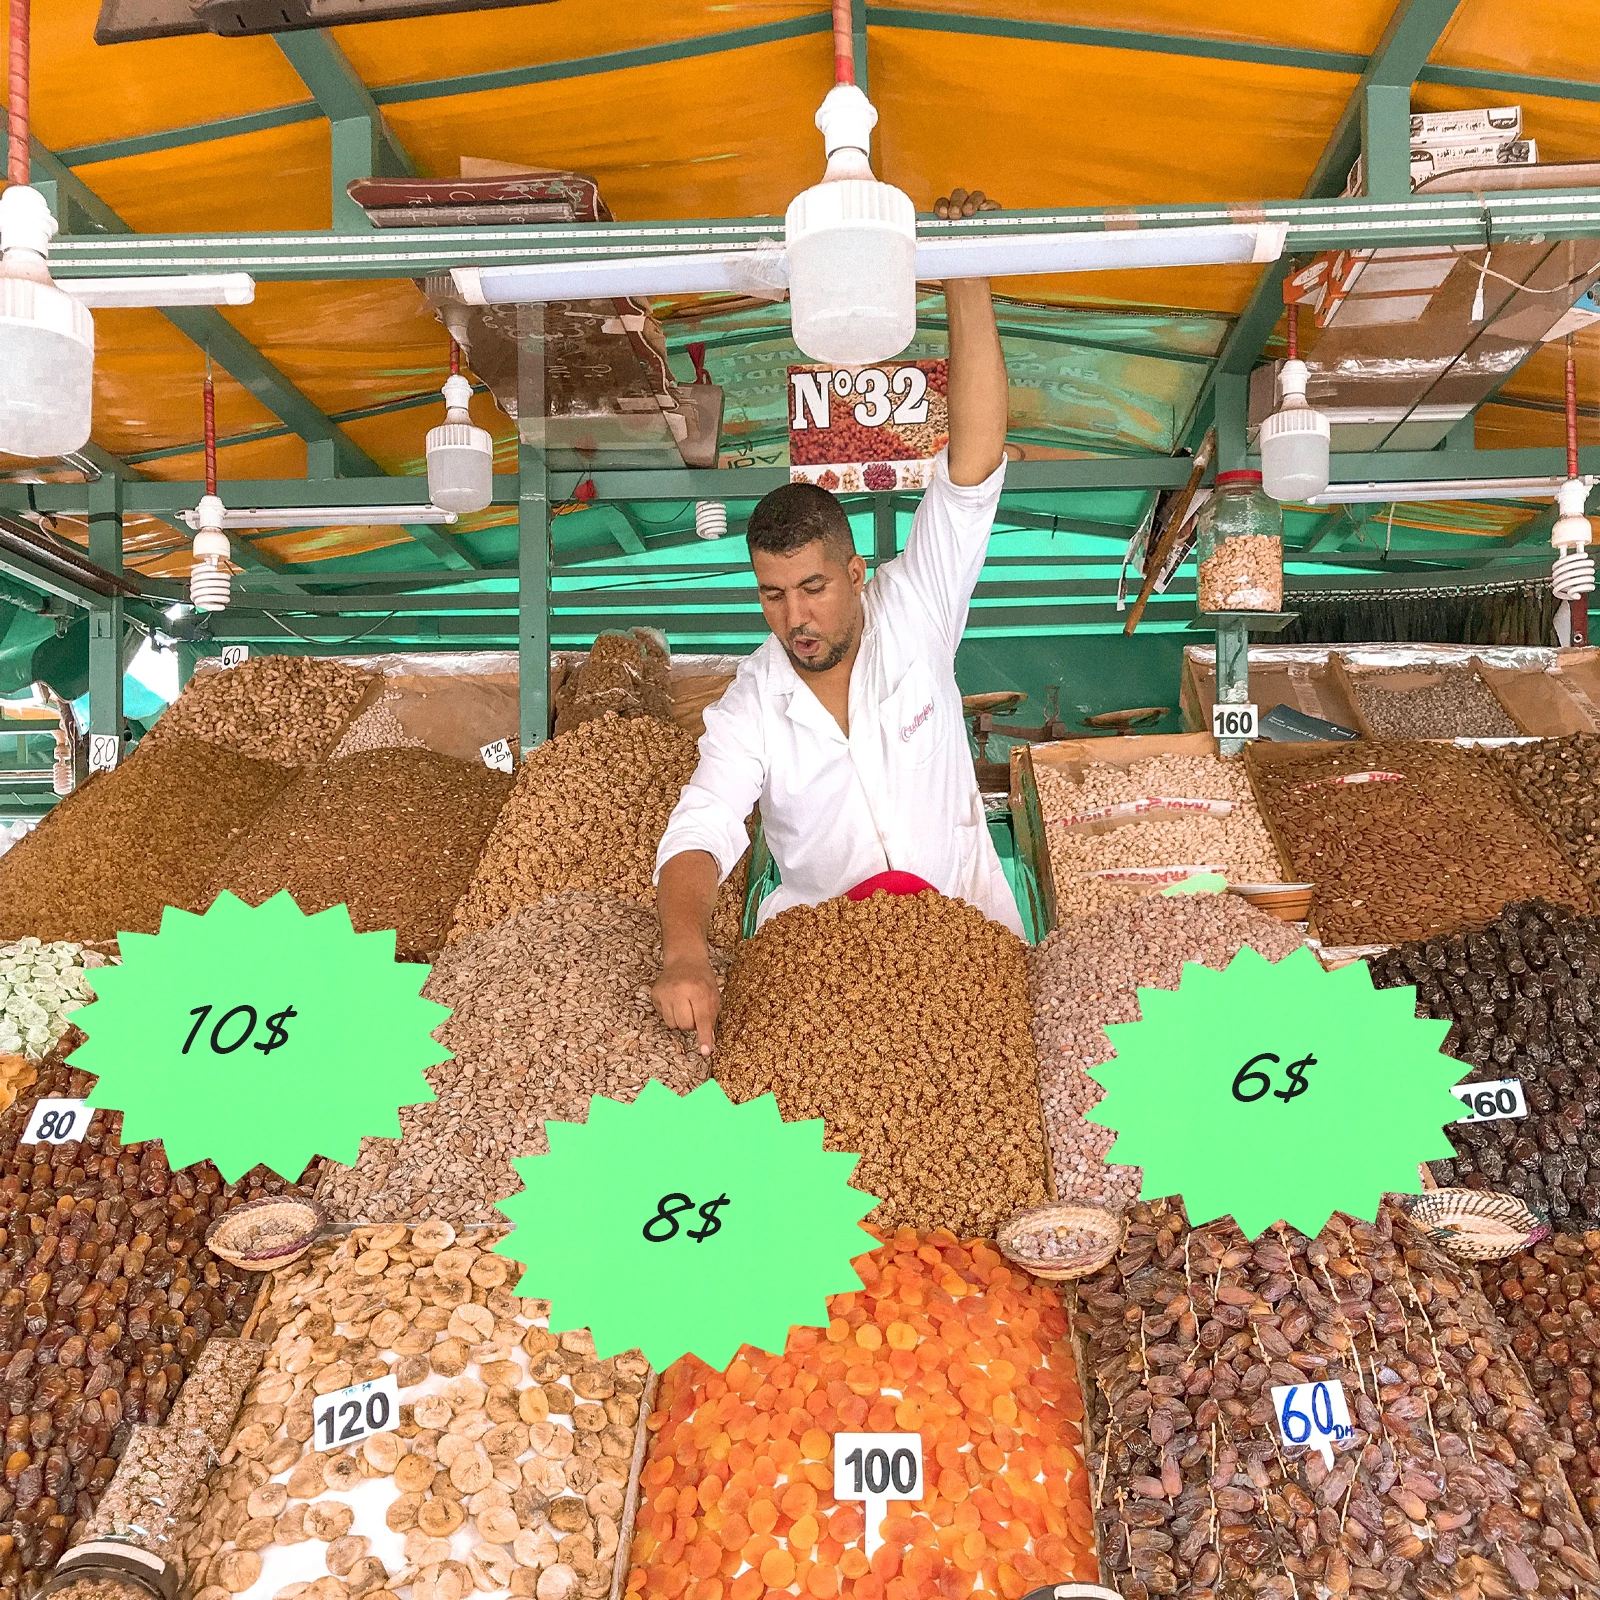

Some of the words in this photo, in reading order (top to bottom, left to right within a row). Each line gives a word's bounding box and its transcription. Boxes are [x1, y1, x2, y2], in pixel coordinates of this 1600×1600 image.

[223, 647, 241, 666] 60
[1214, 711, 1252, 735] 160
[93, 736, 116, 766] 80
[484, 741, 503, 758] 140
[36, 1110, 76, 1139] 80
[317, 1391, 390, 1445] 120
[1281, 1382, 1334, 1443] 60
[1333, 1424, 1356, 1440] DH
[844, 1447, 917, 1495] 100
